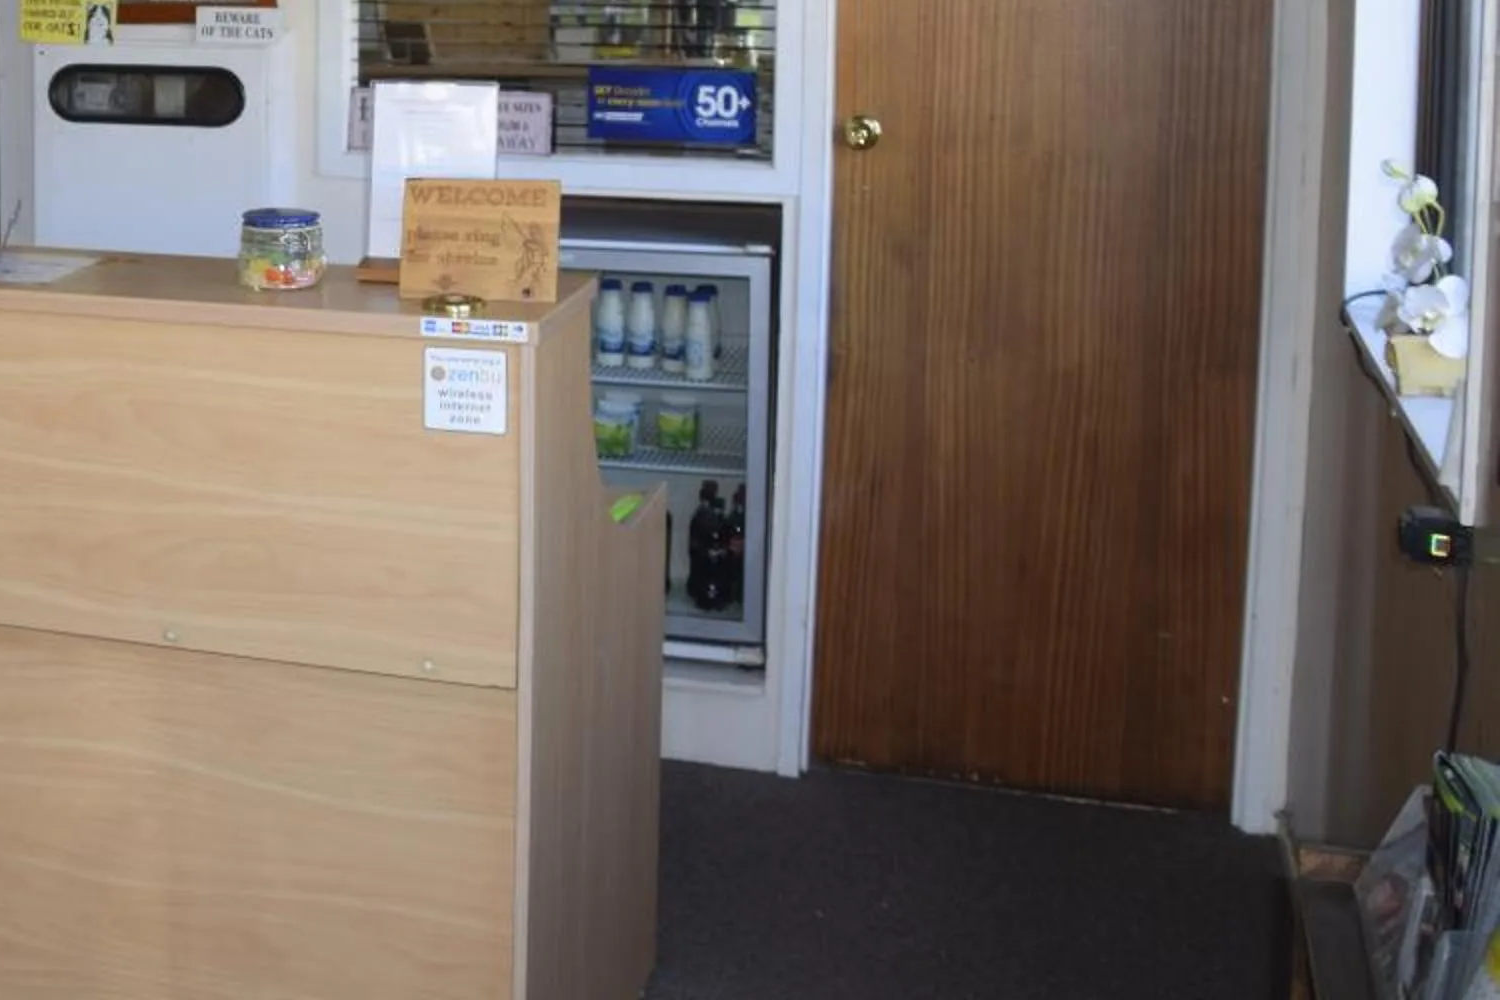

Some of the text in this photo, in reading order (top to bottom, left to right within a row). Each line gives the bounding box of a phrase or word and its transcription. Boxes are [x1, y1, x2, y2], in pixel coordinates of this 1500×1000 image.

[215, 11, 260, 24] BEWARE
[201, 26, 273, 39] OF THE CATS
[695, 84, 751, 119] 50+
[410, 185, 548, 208] WELCOME
[464, 228, 502, 247] ring
